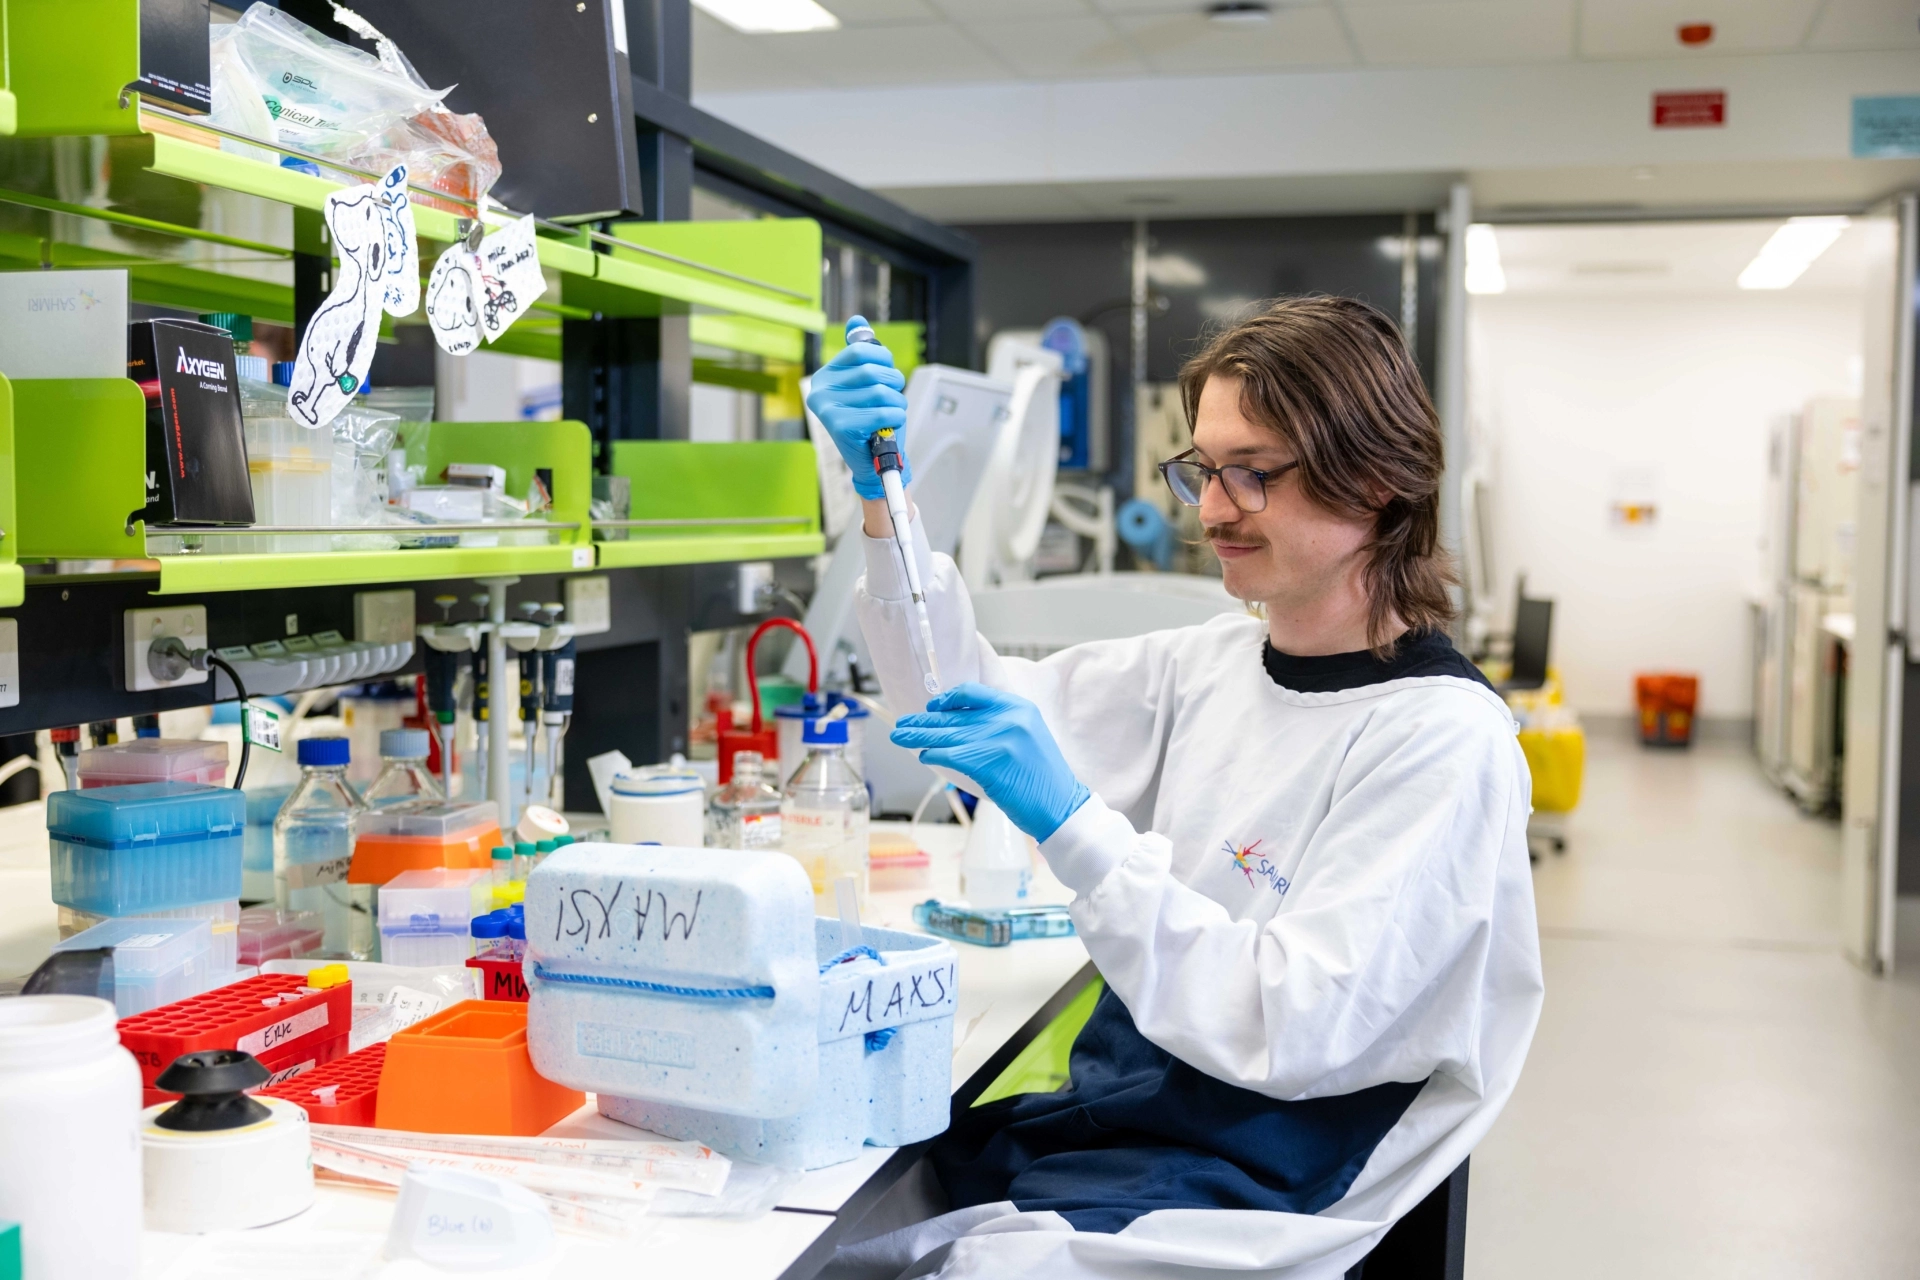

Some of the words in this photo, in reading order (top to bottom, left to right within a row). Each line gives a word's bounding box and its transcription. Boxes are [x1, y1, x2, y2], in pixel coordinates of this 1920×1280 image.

[265, 100, 315, 125] Conical
[27, 297, 76, 312] SAHMRI
[170, 387, 185, 479] www.axygen.com
